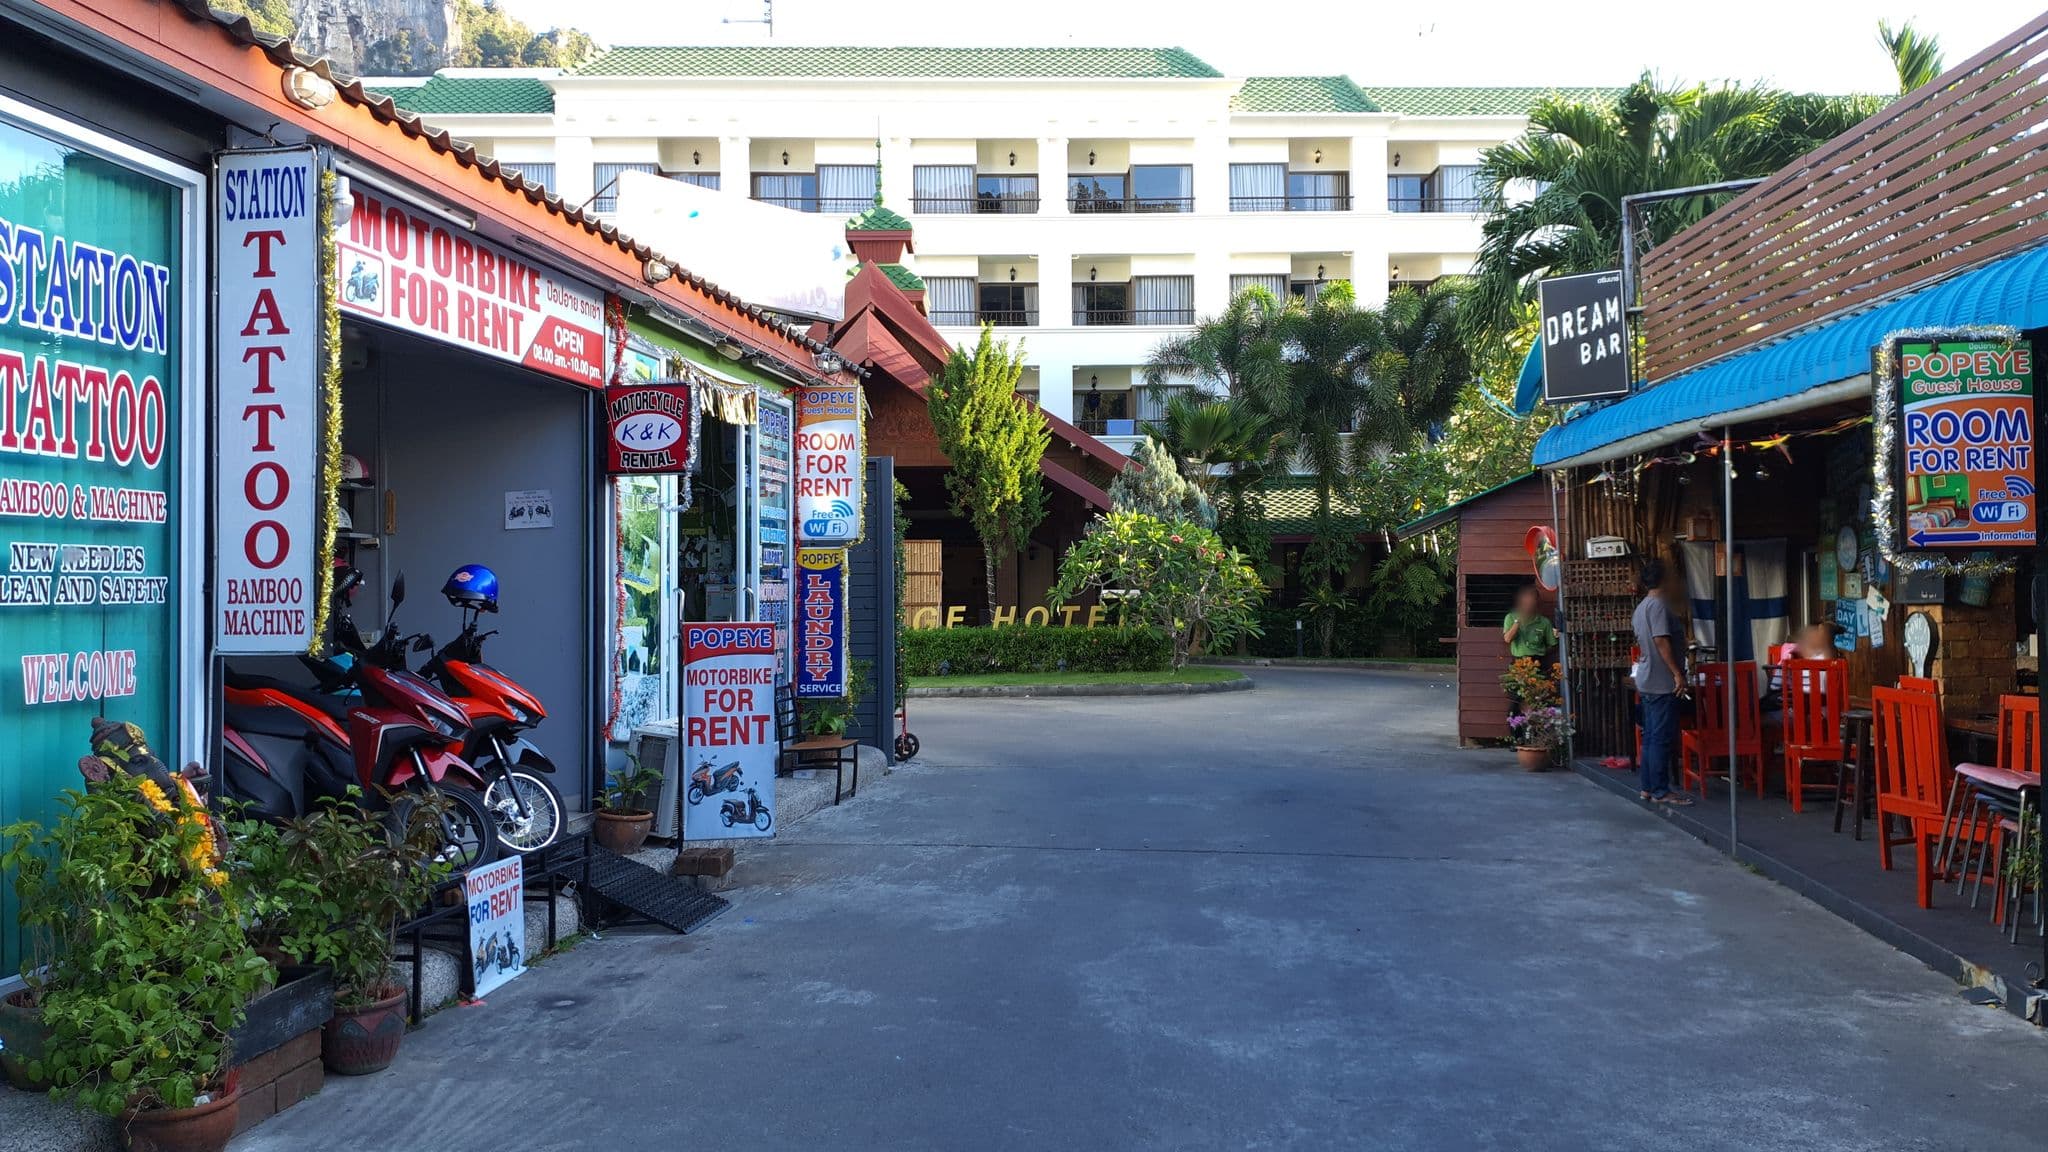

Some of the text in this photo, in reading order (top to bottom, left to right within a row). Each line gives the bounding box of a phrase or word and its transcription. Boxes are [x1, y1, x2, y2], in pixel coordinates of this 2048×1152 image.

[226, 167, 306, 222] STATION
[350, 191, 540, 312] MOTORBIKE
[391, 265, 524, 356] FOR RENT
[1546, 296, 1620, 345] DREAM
[533, 343, 554, 364] 08.00
[554, 325, 584, 355] OPEN
[1580, 333, 1622, 365] BAR
[1902, 350, 2031, 378] POPEYE
[800, 391, 855, 404] POPEYE
[1911, 378, 2023, 393] Guest House
[0, 348, 166, 469] TATTOO
[241, 230, 290, 570] TATTOO
[612, 390, 685, 420] MOTORCYCLE
[827, 406, 853, 414] House
[759, 407, 788, 440] POPEYE
[1905, 407, 2031, 446] ROOM
[799, 433, 855, 450] ROOM
[621, 450, 677, 469] RENTAL
[806, 454, 847, 475] FOR
[1907, 446, 2031, 473] FOR RENT
[0, 479, 167, 524] AMBOO & MACHINE
[801, 478, 853, 498] RENT
[1979, 489, 2007, 499] Free
[812, 509, 834, 519] Free
[1981, 529, 2037, 541] Information
[10, 542, 58, 572] NEW
[802, 553, 839, 564] POPEYE
[0, 575, 167, 605] LEAN AND SAFETY
[227, 577, 303, 605] BAMBOO
[224, 610, 305, 635] MACHINE
[805, 574, 835, 682] LAUNDRY
[688, 628, 773, 648] POPEYE
[22, 650, 136, 705] WELCOME
[687, 668, 772, 686] MOTORBIKE
[800, 683, 841, 693] SERVICE
[704, 688, 754, 713] FOR
[688, 715, 770, 747] RENT
[468, 862, 520, 896] MOTORBIKE
[471, 884, 520, 926] FOR RENT
